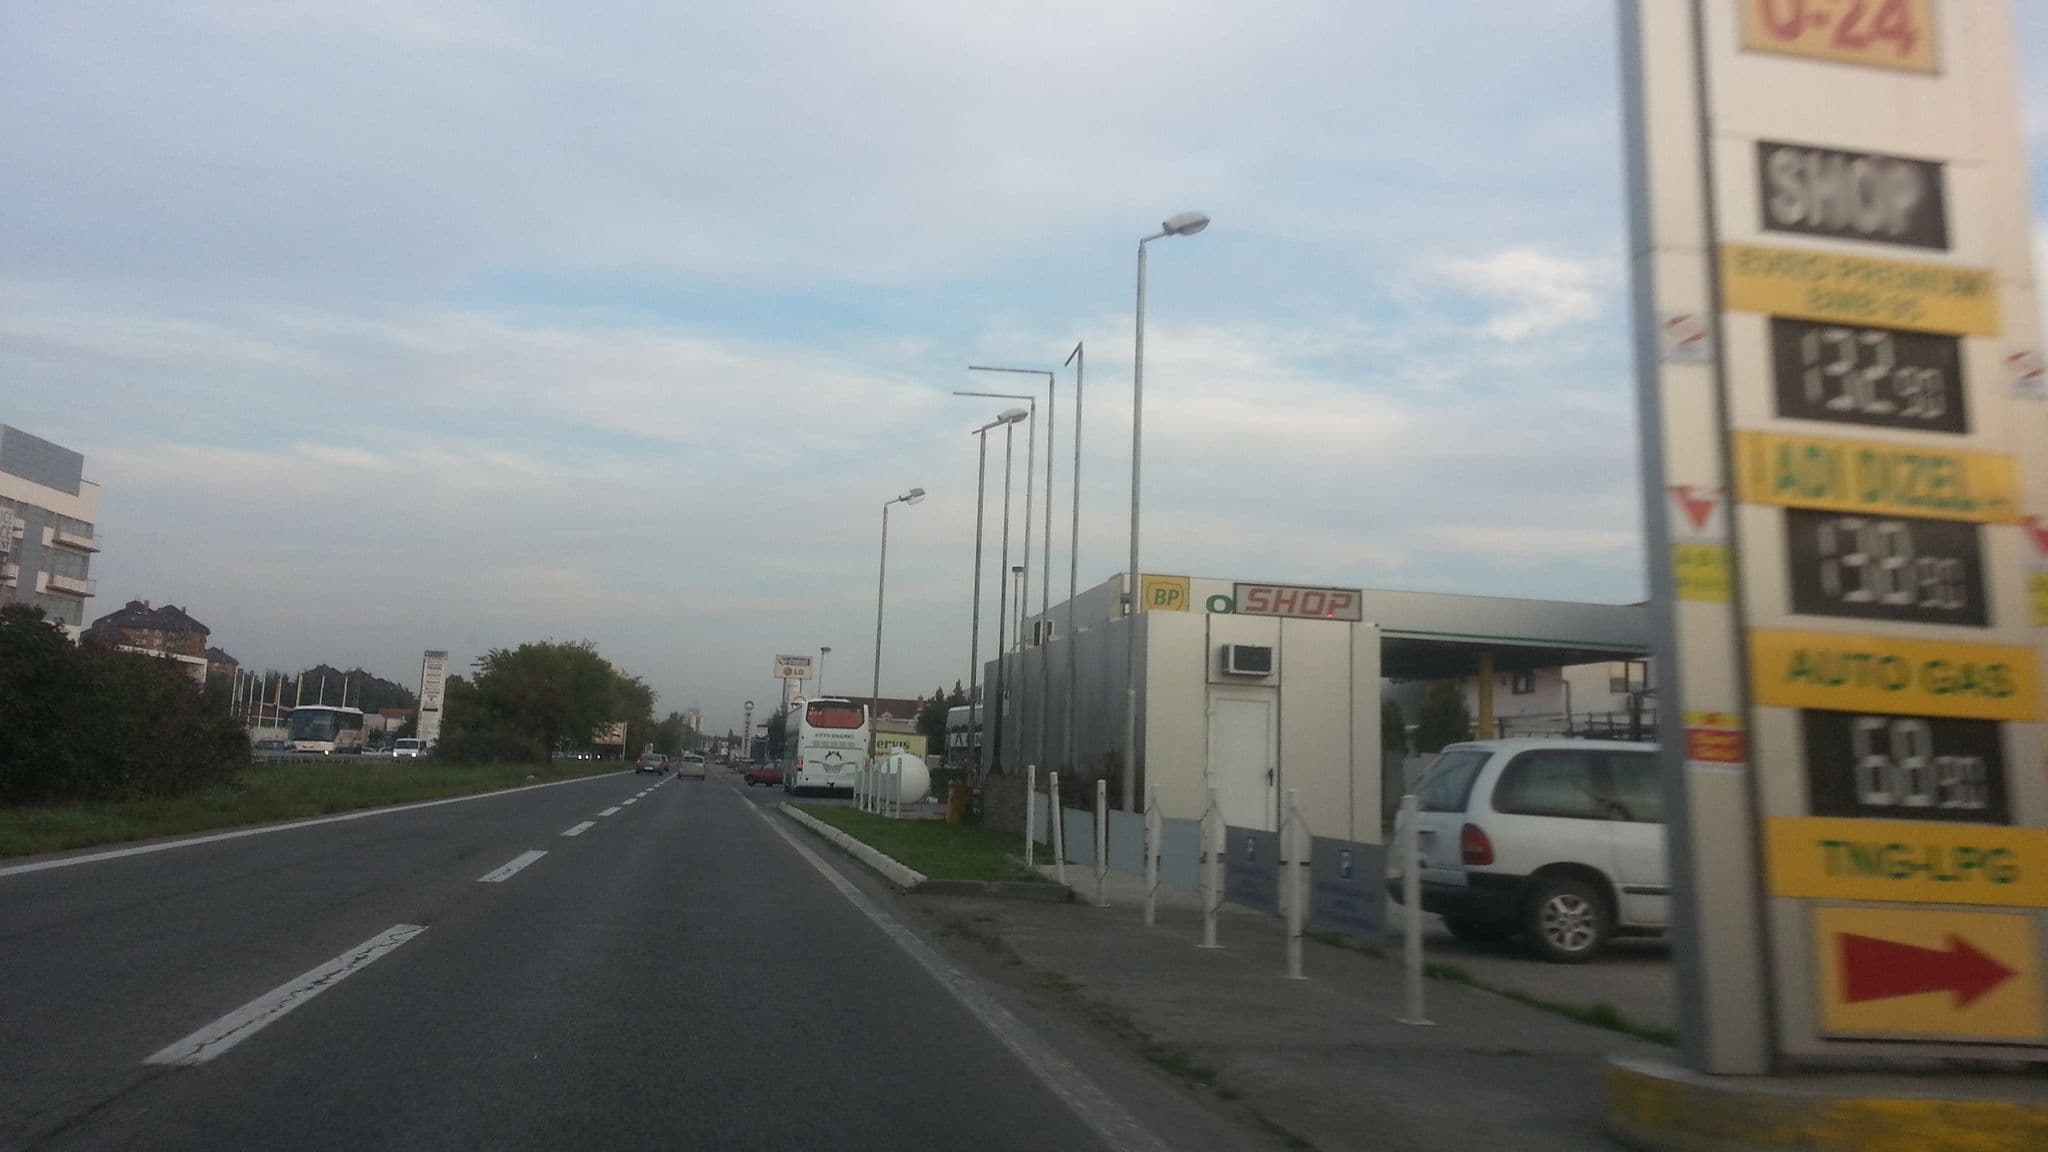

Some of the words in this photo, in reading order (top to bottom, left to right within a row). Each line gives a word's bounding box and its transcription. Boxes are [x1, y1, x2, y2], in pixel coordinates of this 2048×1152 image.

[1767, 146, 1922, 235] SHOP
[1153, 588, 1180, 606] BP
[1245, 586, 1352, 619] SHOP
[793, 668, 804, 676] LG
[1787, 646, 1911, 692] AUTO
[1919, 657, 2016, 698] GAS
[876, 739, 911, 750] ervis
[1816, 837, 2021, 886] TNG-LPG
